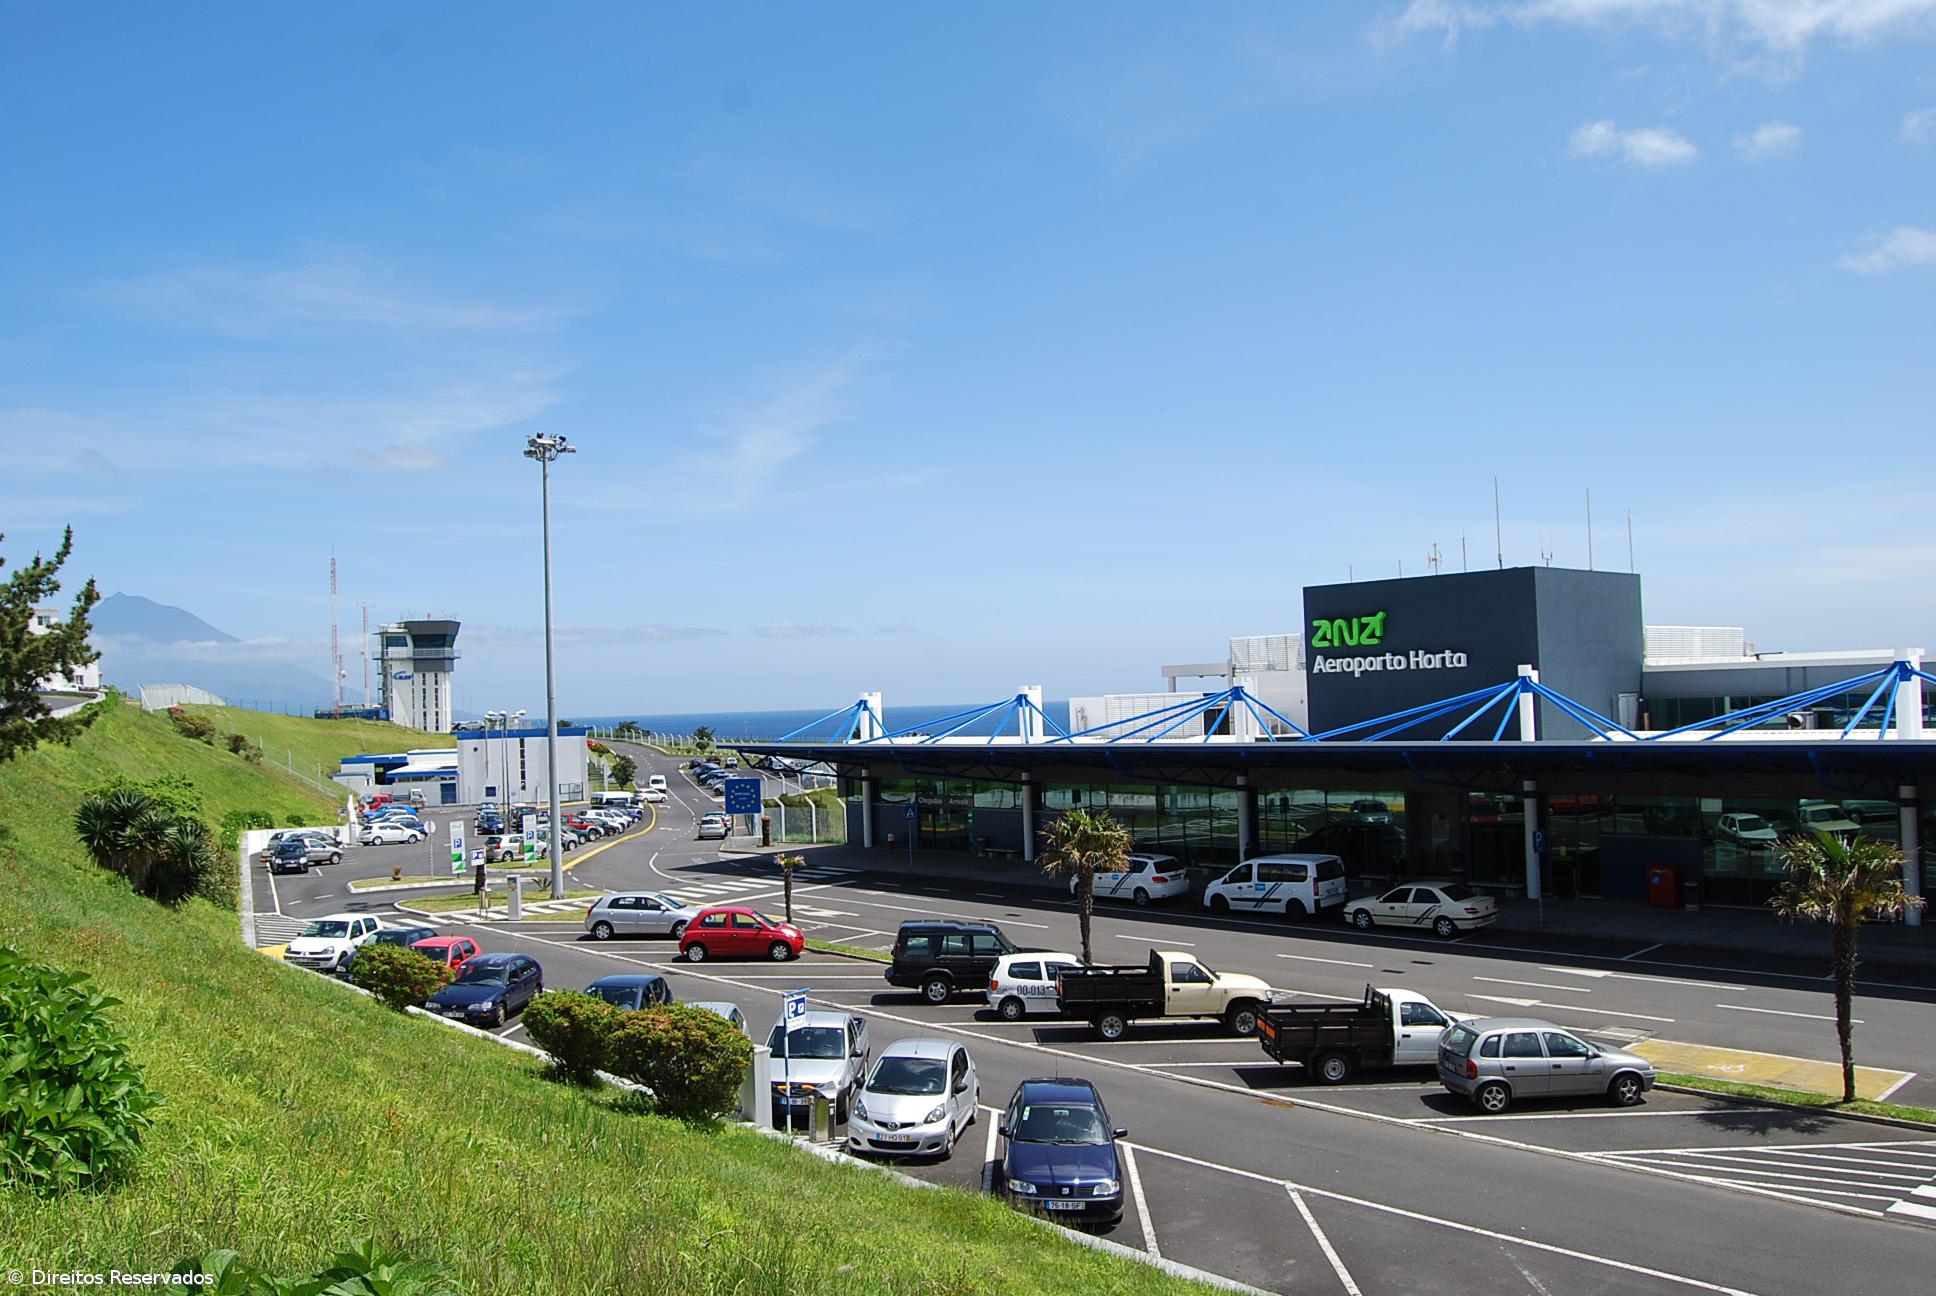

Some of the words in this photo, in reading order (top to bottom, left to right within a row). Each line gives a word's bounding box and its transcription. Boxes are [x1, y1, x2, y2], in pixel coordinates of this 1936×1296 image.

[1312, 652, 1407, 678] Aeroporto
[1409, 649, 1468, 670] Horta
[1016, 984, 1046, 996] 00-013
[788, 1001, 797, 1018] P
